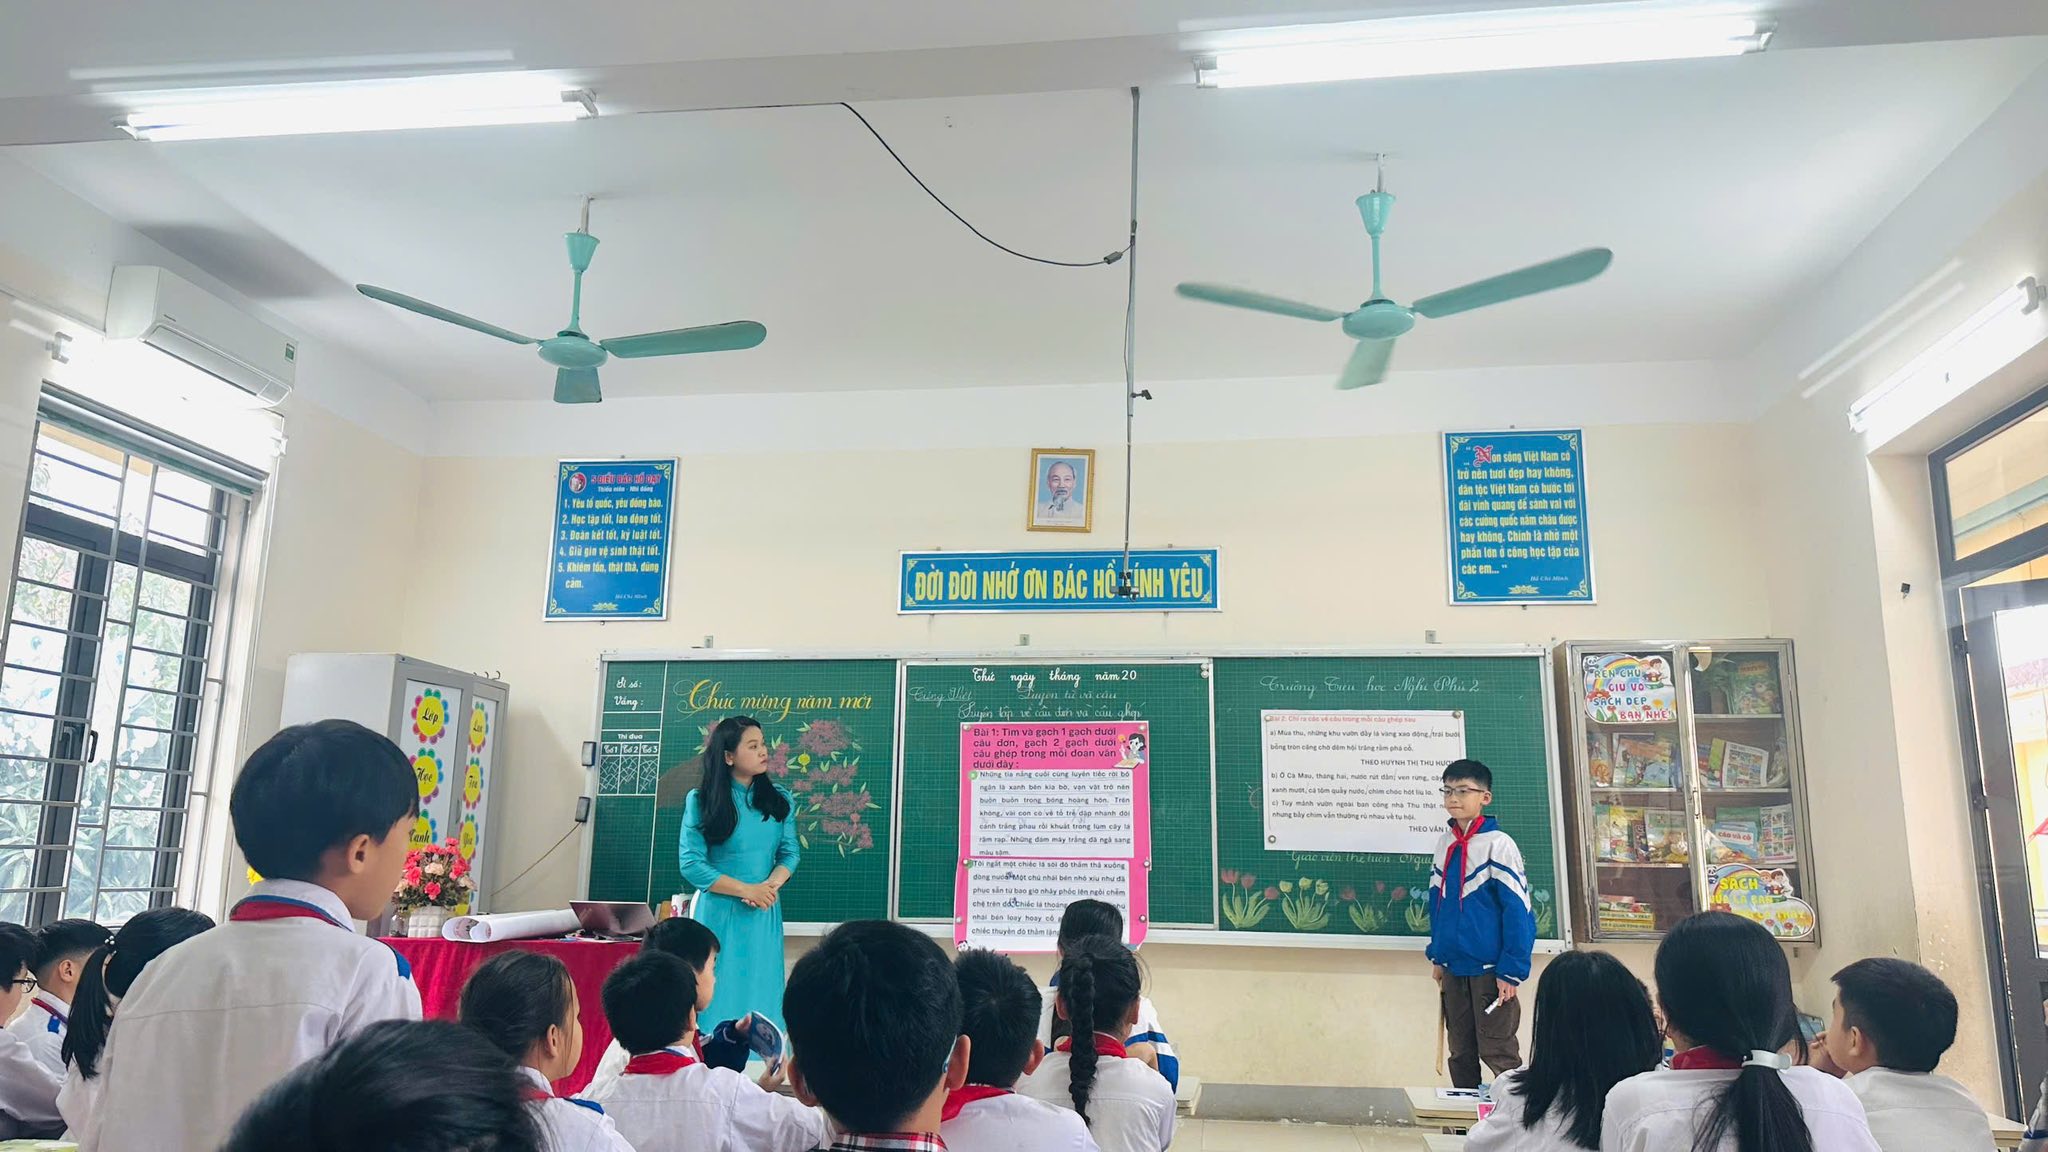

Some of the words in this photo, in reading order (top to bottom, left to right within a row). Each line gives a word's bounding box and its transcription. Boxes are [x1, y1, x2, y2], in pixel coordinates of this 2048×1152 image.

[1541, 452, 1558, 462] Nam
[1527, 467, 1542, 478] hay
[1508, 484, 1527, 494] Nam
[1460, 532, 1474, 543] hay
[915, 563, 943, 600] ĐỜI
[948, 563, 976, 600] ĐỜI
[982, 561, 1020, 599] NHỚ
[1023, 568, 1048, 599] ƠN
[1053, 563, 1088, 599] BÁC
[1094, 559, 1117, 598] HỒ
[1170, 562, 1204, 598] YÊU
[1469, 680, 1479, 692] 2
[680, 679, 736, 714] Chúc
[741, 693, 792, 724] mừng
[796, 695, 836, 710] năm
[840, 693, 872, 709] mới
